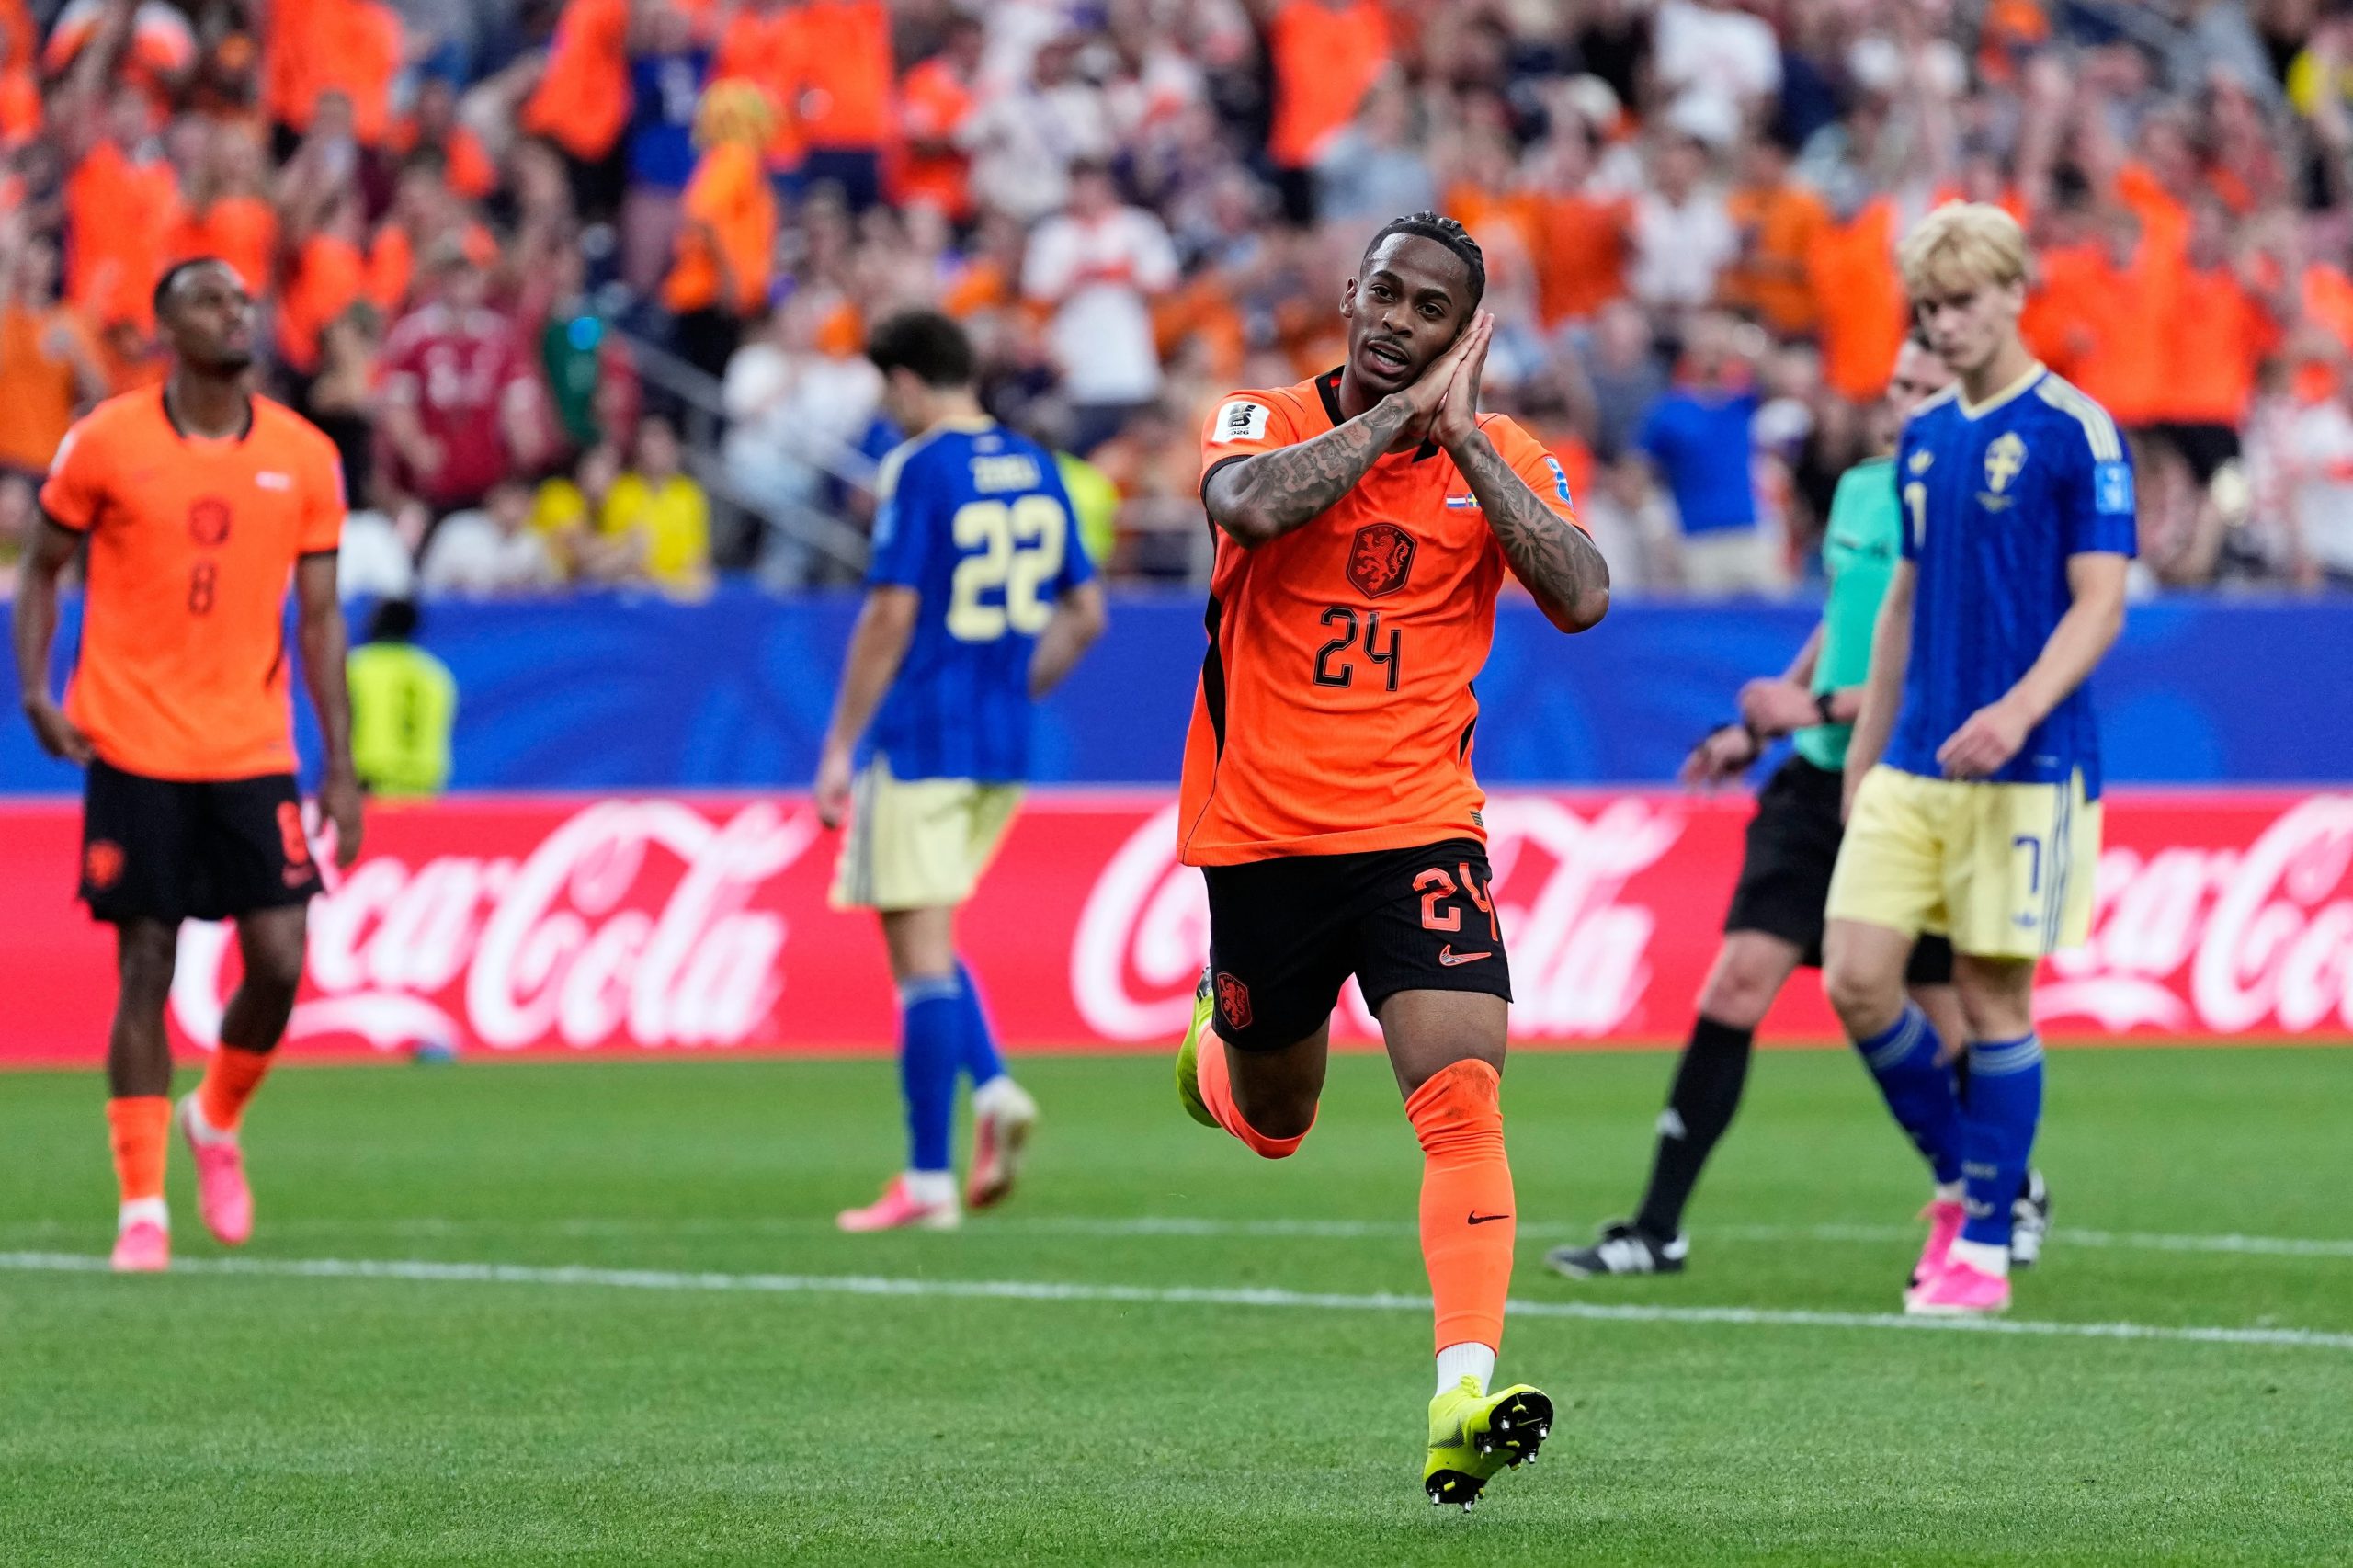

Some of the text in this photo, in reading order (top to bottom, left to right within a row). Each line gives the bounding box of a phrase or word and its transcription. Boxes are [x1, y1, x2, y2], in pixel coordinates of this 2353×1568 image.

[188, 561, 215, 616] 8
[948, 494, 1066, 641] 22
[1313, 606, 1402, 692] 24
[1412, 862, 1499, 941] 24
[2012, 833, 2040, 894] 7
